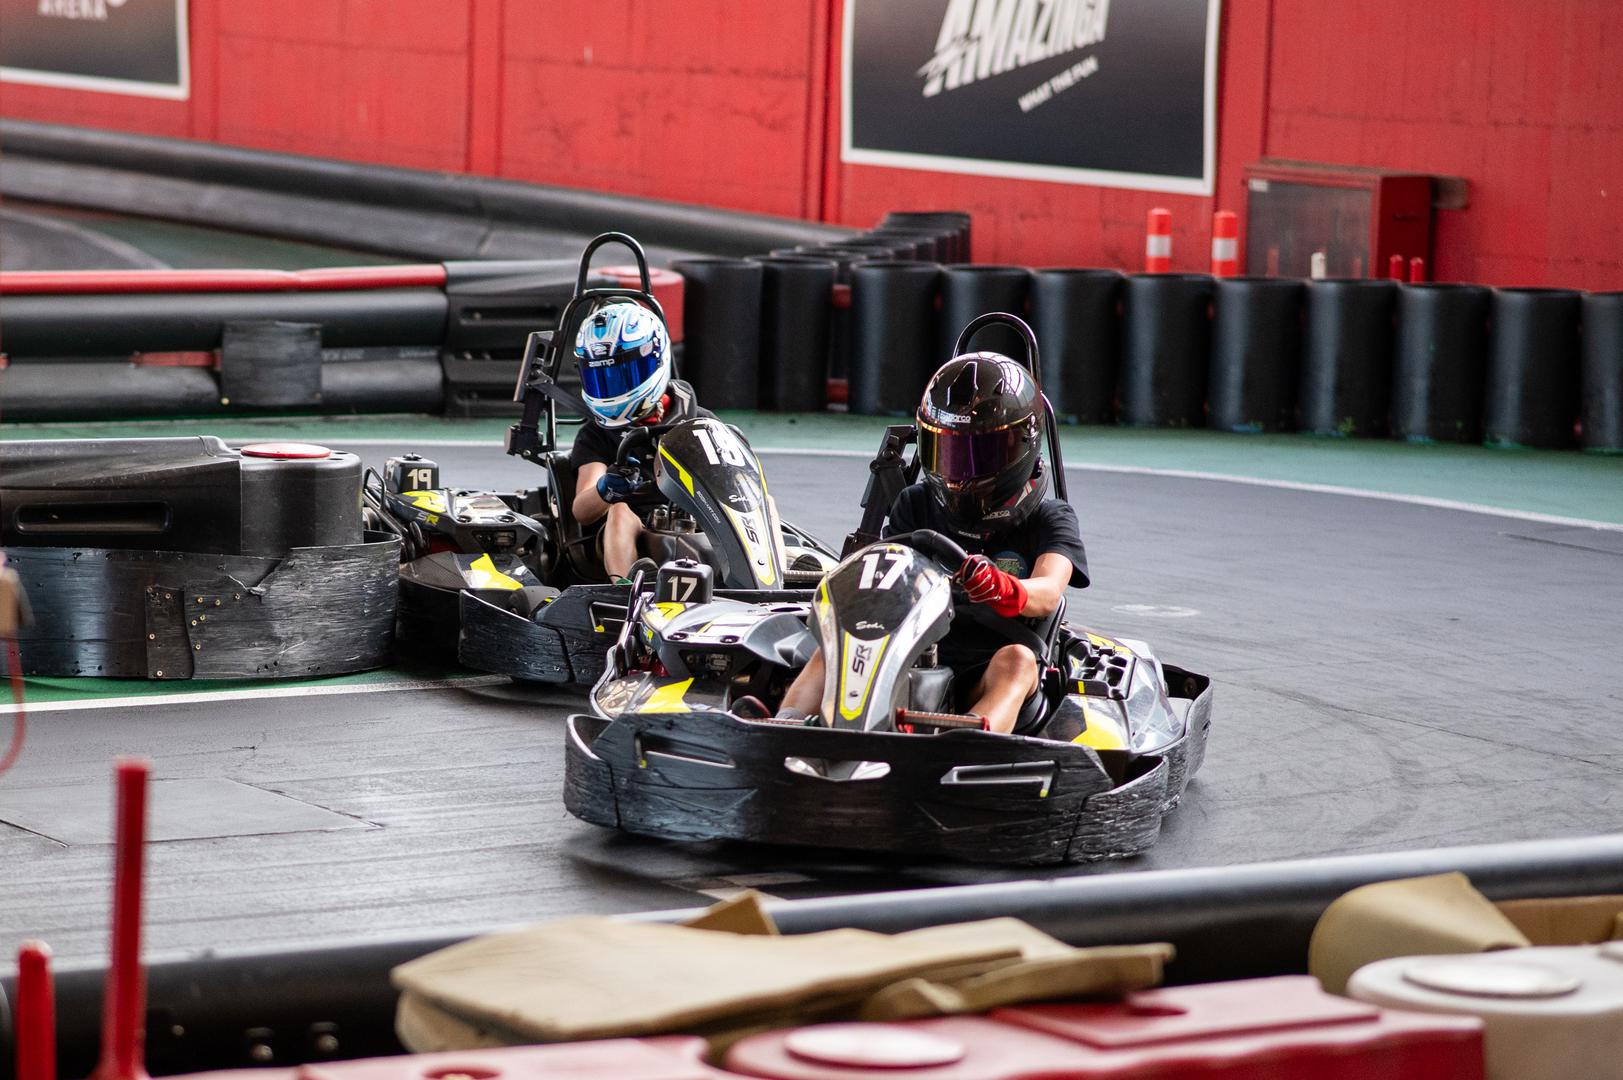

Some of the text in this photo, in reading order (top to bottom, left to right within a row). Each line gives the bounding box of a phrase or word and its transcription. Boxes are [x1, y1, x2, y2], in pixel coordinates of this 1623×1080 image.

[407, 468, 432, 490] 19
[858, 553, 910, 590] 17
[667, 576, 698, 602] 17
